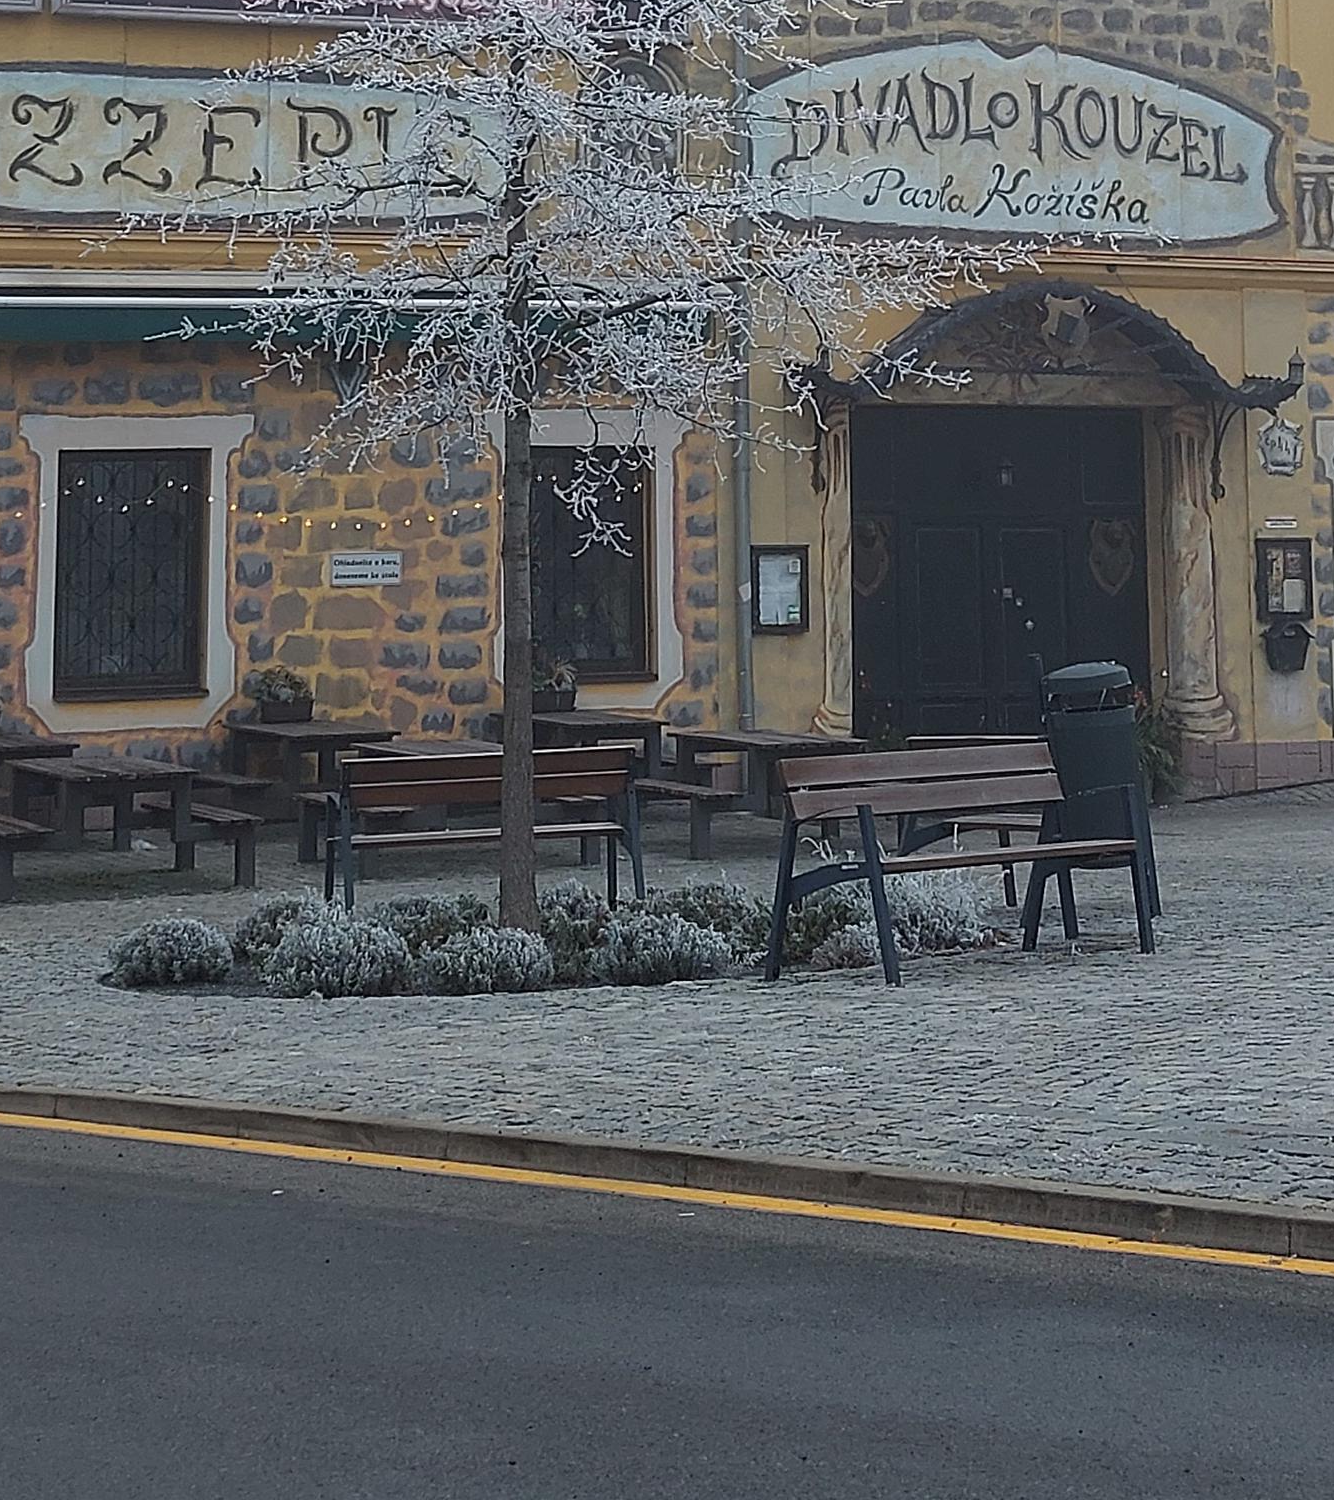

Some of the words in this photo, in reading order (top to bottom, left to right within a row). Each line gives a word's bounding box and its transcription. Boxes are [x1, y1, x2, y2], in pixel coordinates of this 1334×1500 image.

[770, 65, 1019, 178] DIVADLO
[1027, 78, 1249, 184] KOUZEL
[863, 166, 969, 213] Pavla
[974, 163, 1151, 225] Kožíška
